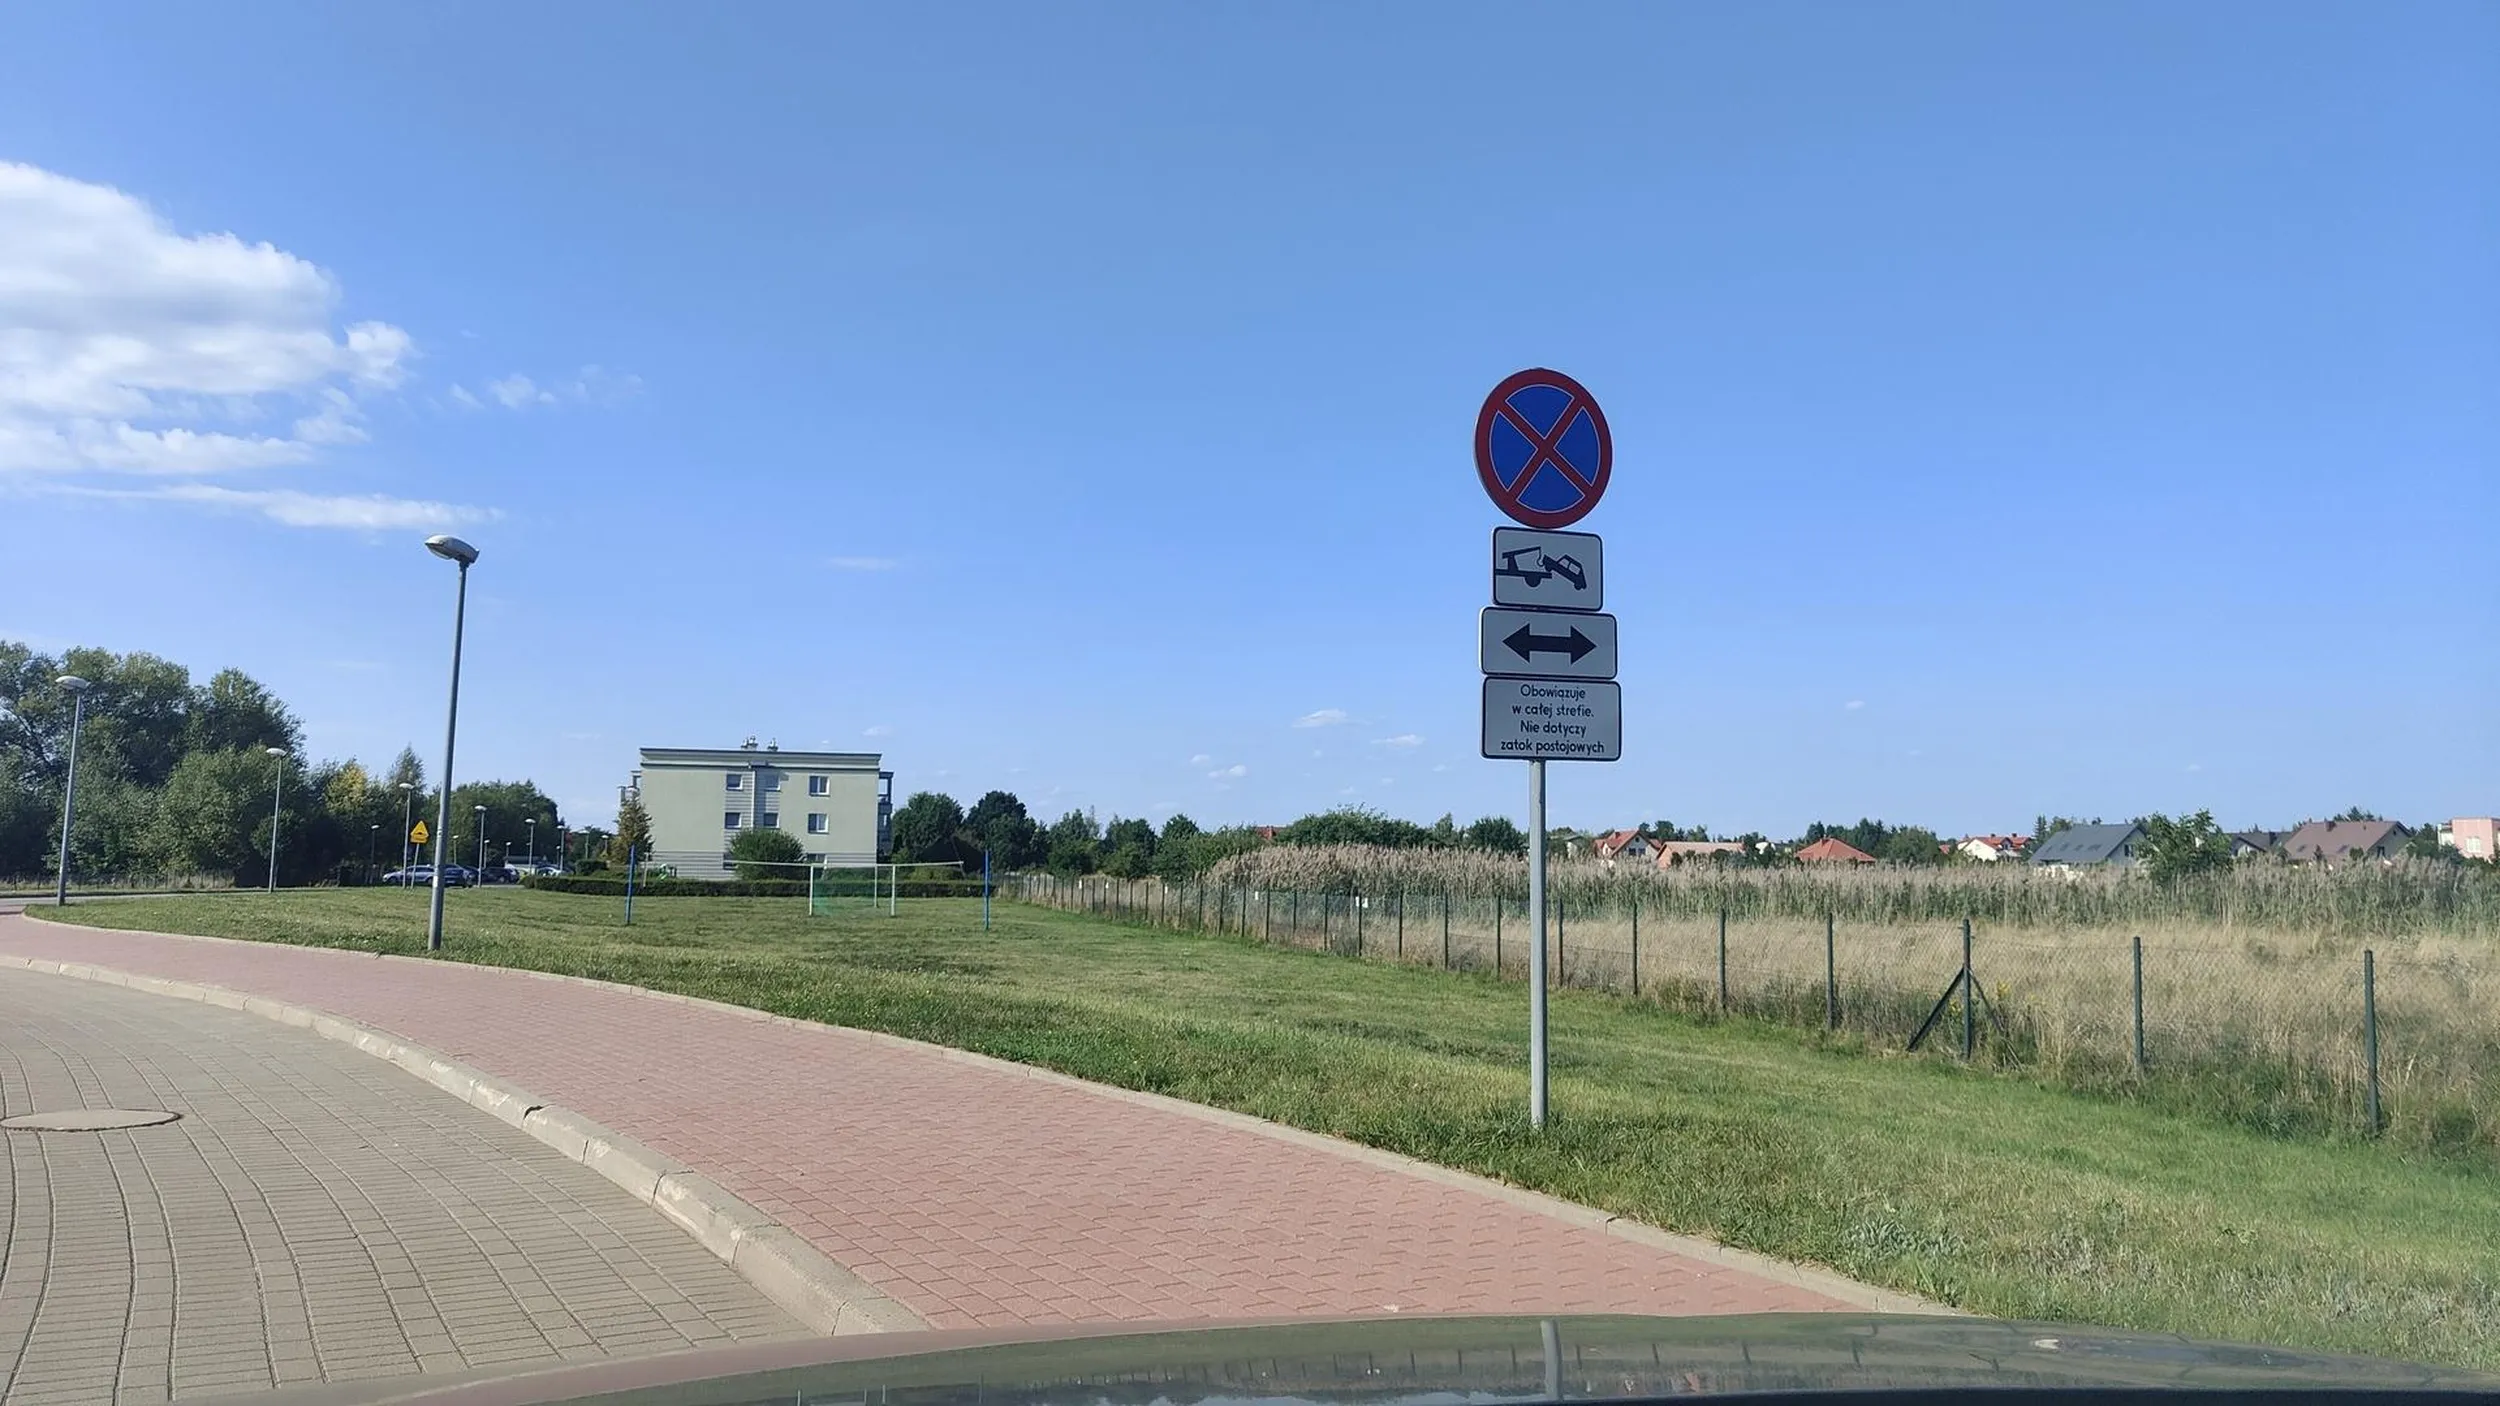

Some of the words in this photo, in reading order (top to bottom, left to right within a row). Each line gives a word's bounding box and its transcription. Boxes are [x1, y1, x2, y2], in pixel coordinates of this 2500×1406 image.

[1520, 684, 1586, 701] Obowiązuje
[1511, 705, 1521, 714] w
[1524, 702, 1552, 718] całej
[1556, 704, 1594, 717] strefie.
[1520, 720, 1540, 733] Nie
[1542, 721, 1586, 738] dotyczy
[1500, 738, 1532, 751] zatok
[1536, 740, 1604, 755] postojowych
